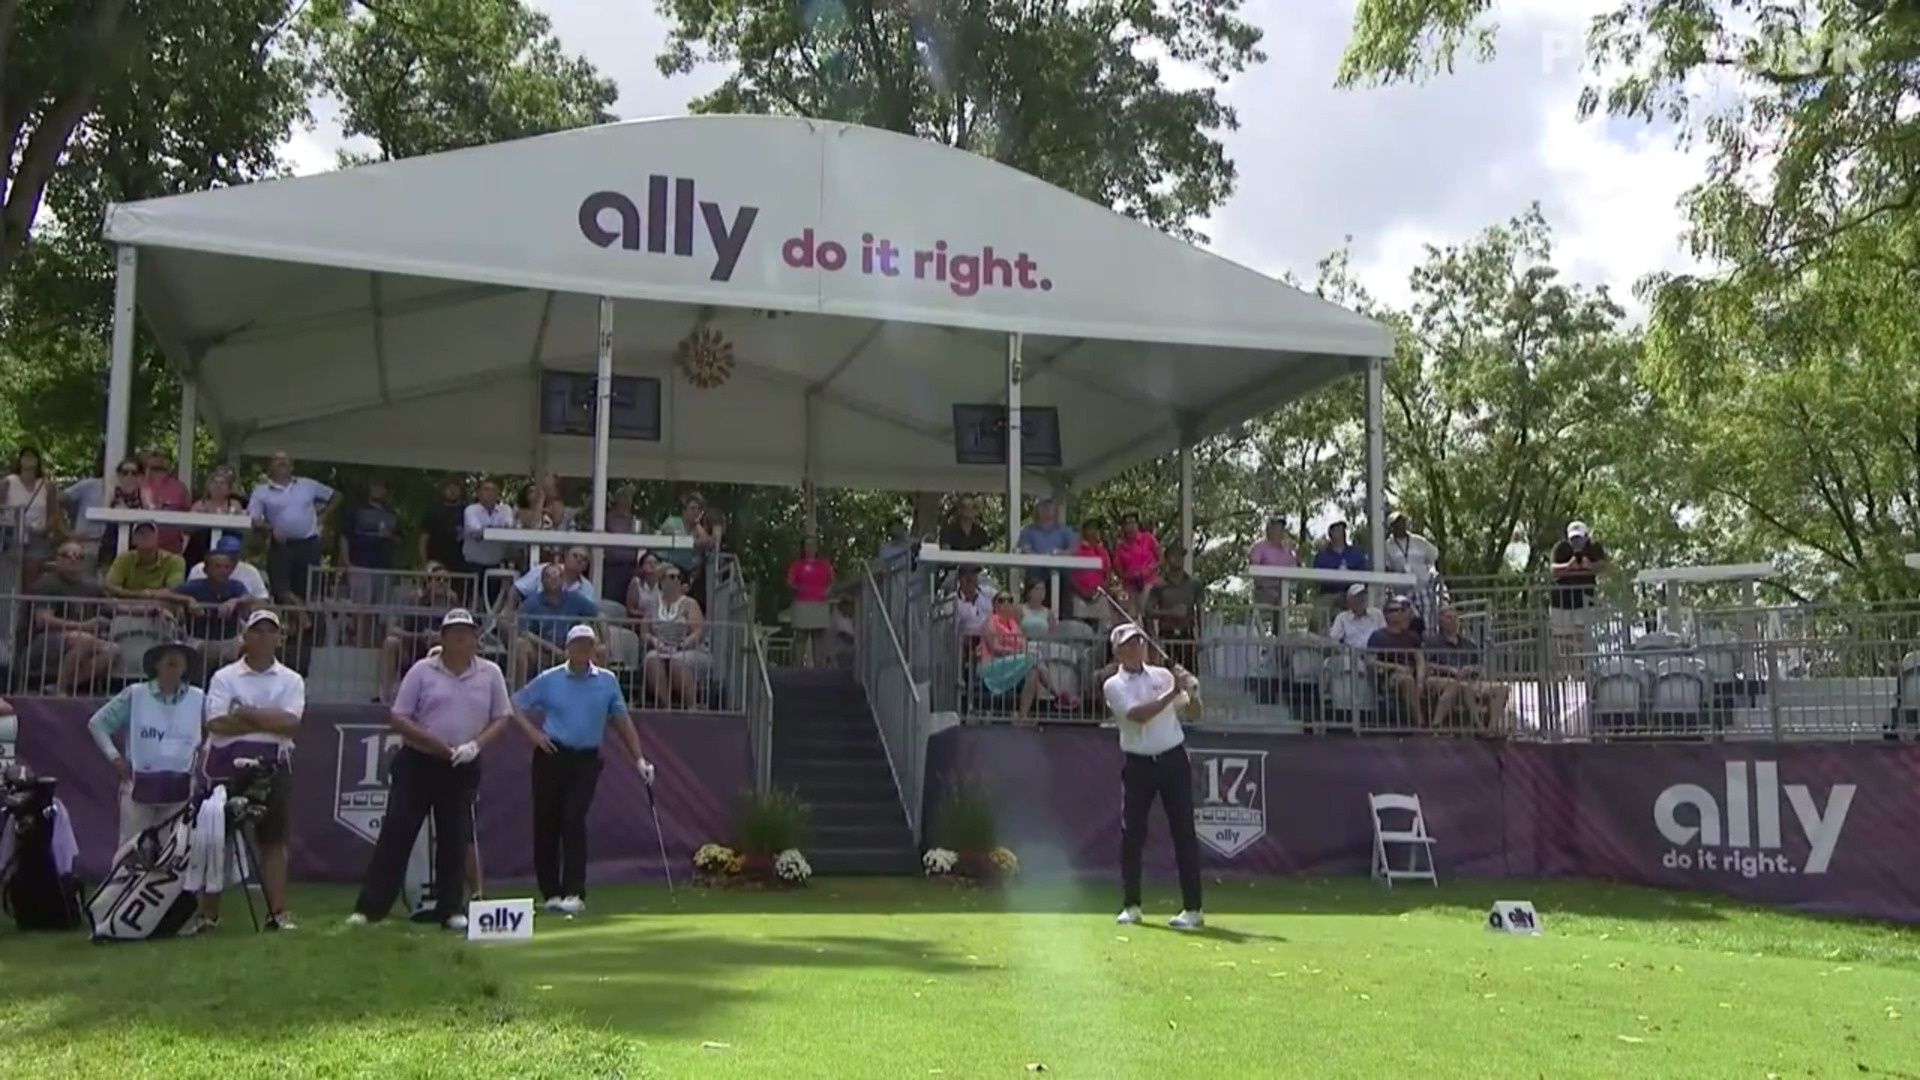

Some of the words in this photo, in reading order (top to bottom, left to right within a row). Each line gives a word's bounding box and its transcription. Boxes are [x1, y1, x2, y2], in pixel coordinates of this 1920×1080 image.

[578, 174, 759, 281] ally
[781, 228, 847, 271] do
[861, 232, 899, 276] it
[913, 239, 1053, 297] right.
[141, 727, 165, 742] ally
[1202, 757, 1249, 804] 17
[1653, 760, 1858, 874] ally
[1216, 828, 1240, 844] ally
[1662, 848, 1692, 869] do
[1698, 850, 1717, 870] it
[1723, 851, 1797, 878] right.
[478, 907, 524, 932] ally
[1508, 907, 1535, 928] ally
